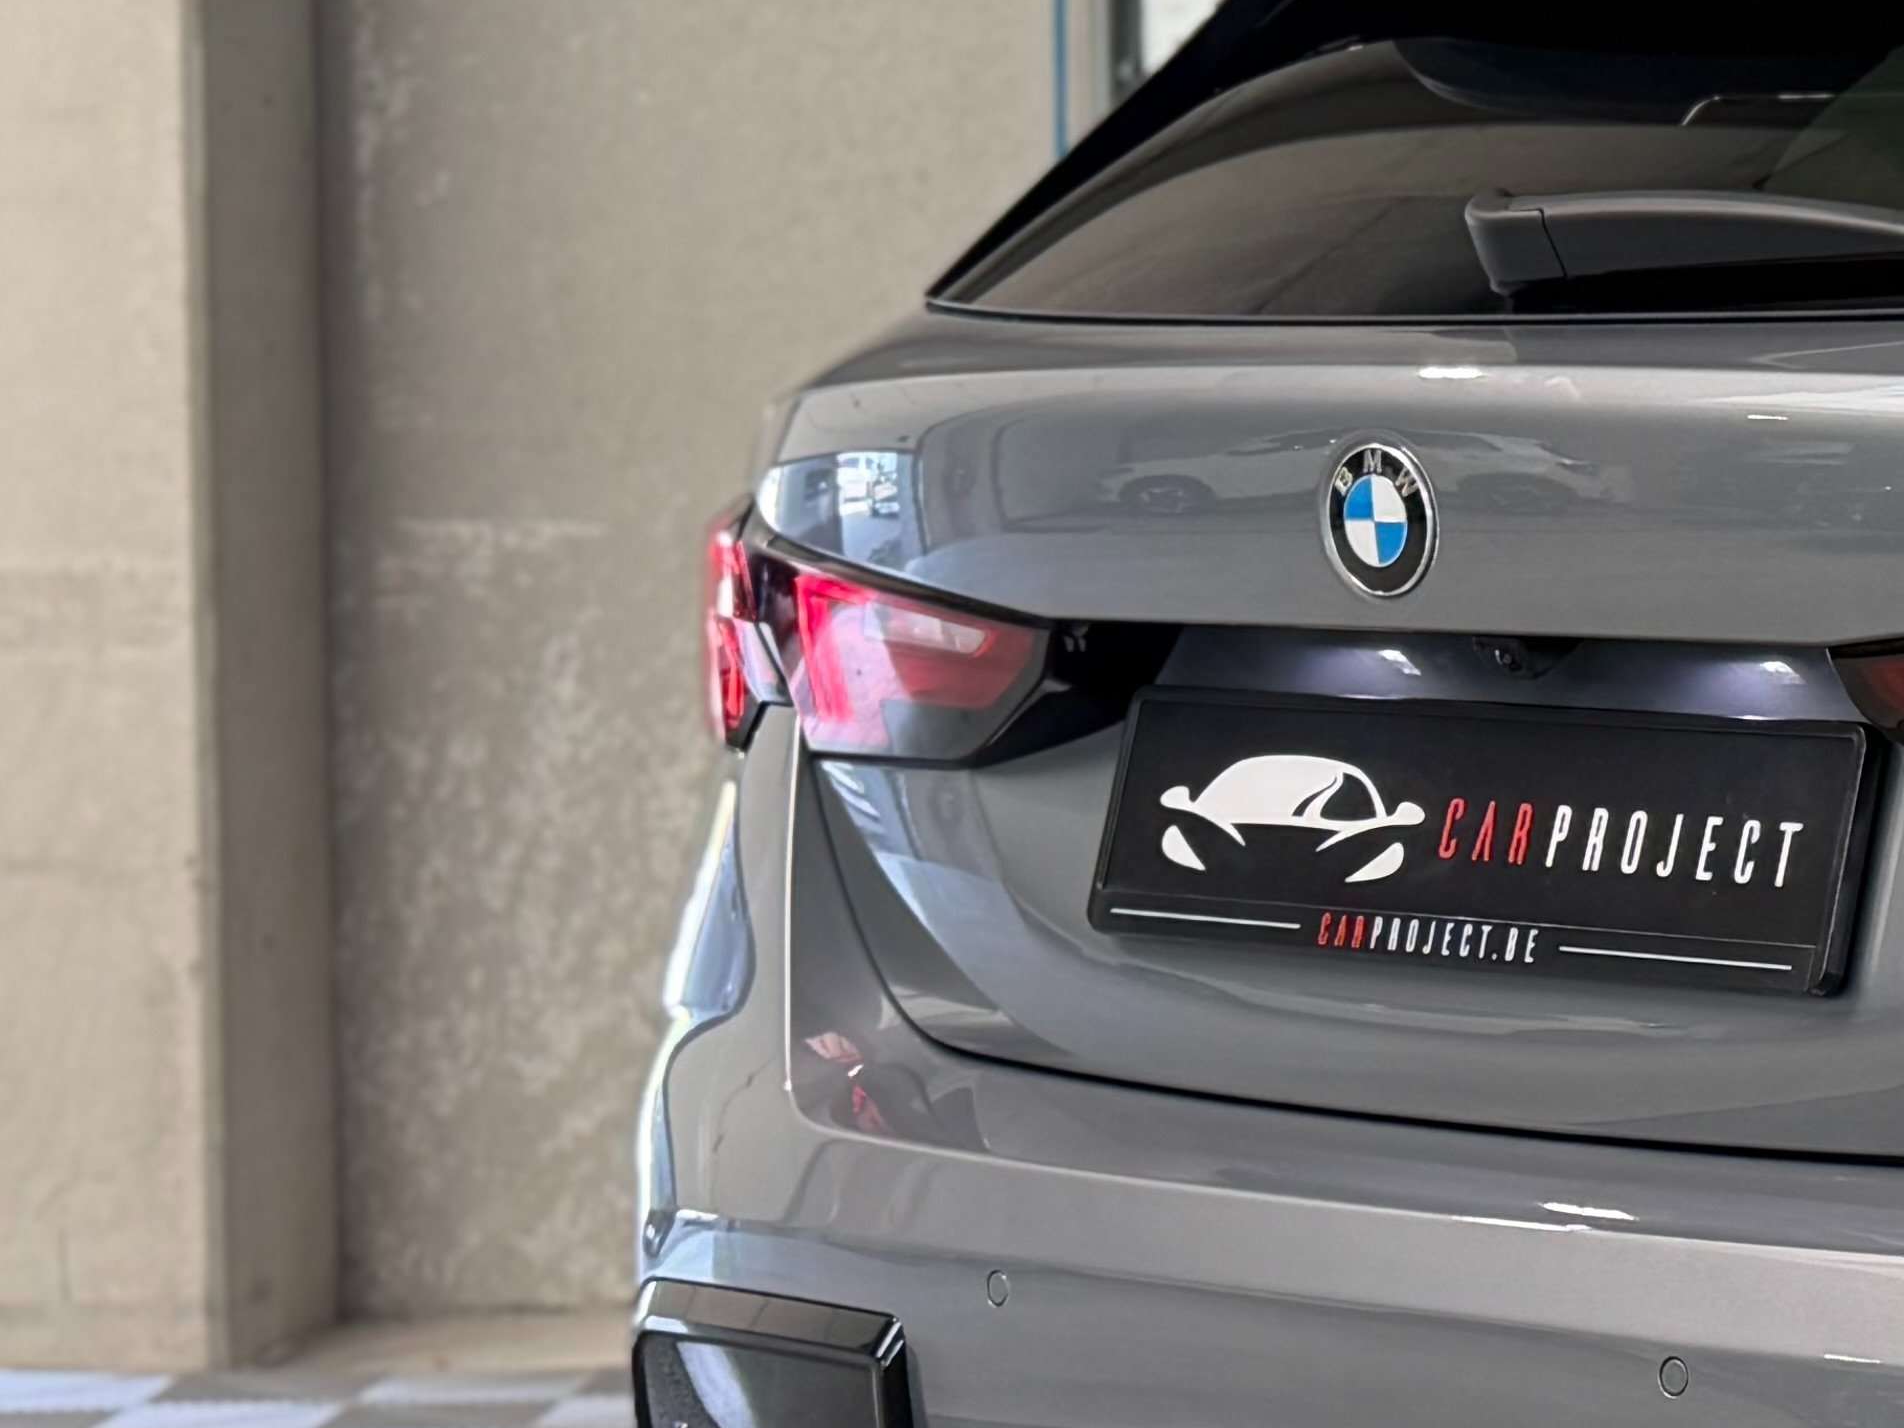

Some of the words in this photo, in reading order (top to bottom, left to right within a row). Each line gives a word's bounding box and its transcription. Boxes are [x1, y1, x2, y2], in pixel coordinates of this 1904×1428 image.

[1334, 449, 1419, 497] BMW
[1438, 797, 1804, 888] CARPROJECT
[1317, 912, 1539, 964] CARPROJECT.BE
